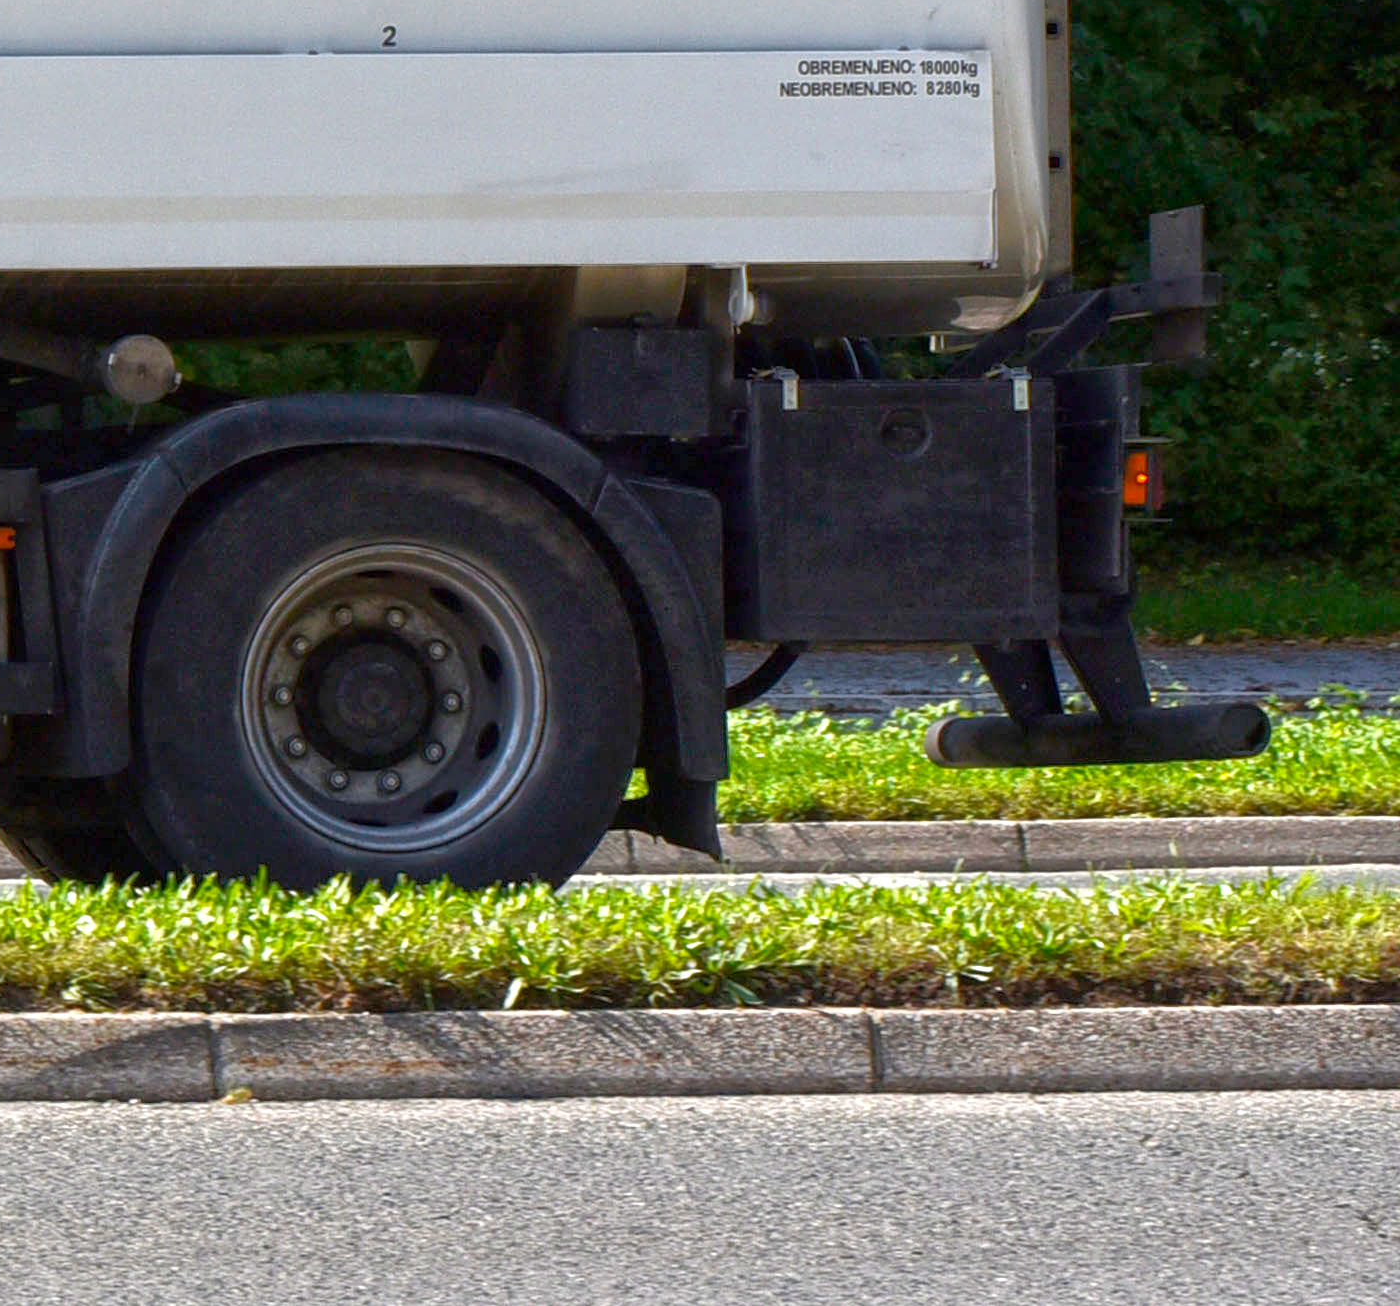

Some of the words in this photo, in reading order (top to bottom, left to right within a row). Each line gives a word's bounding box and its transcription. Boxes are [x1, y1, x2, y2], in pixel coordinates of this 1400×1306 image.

[381, 25, 397, 47] 2
[798, 60, 916, 75] OBREMENJENO:
[779, 81, 918, 97] NEOBREMENJENO:
